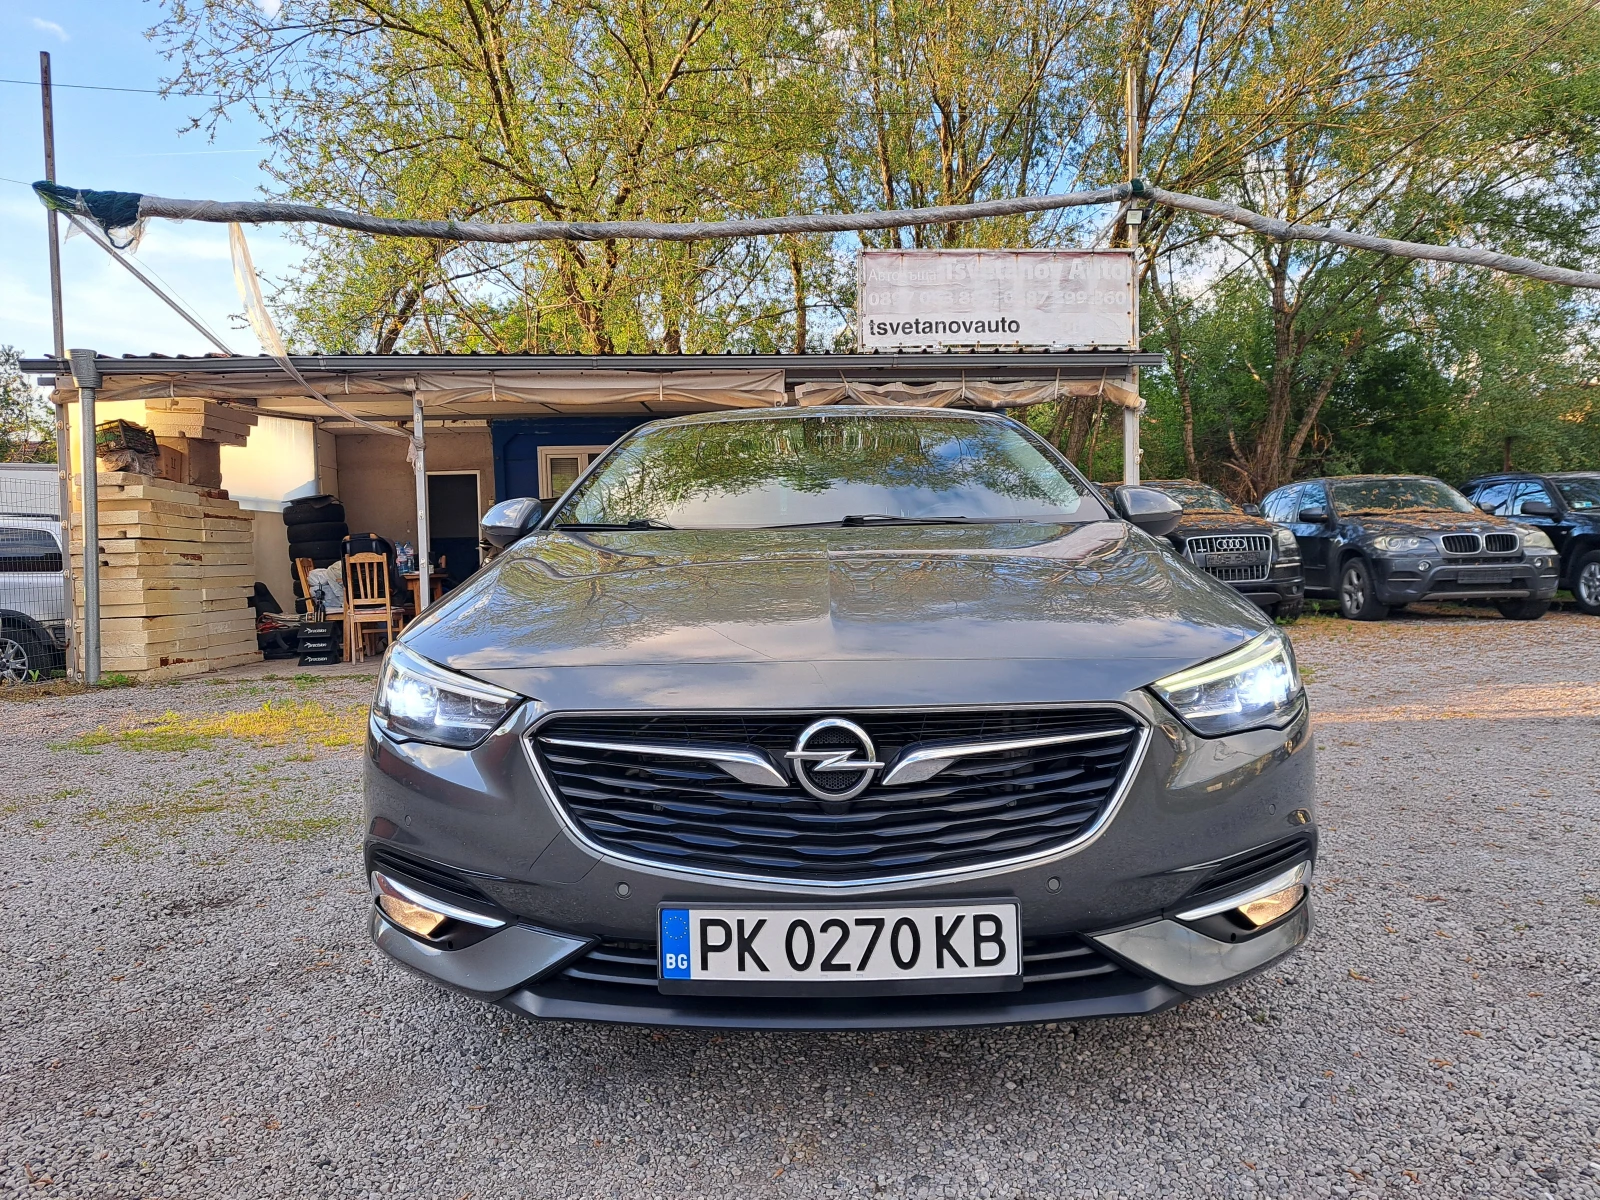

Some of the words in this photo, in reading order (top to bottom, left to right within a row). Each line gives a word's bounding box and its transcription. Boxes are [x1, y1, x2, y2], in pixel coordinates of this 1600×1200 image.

[869, 316, 1020, 336] tsvetanovauto
[699, 917, 770, 972] PK
[784, 916, 921, 972] 0270
[934, 913, 1007, 968] KB
[665, 953, 688, 970] BG
